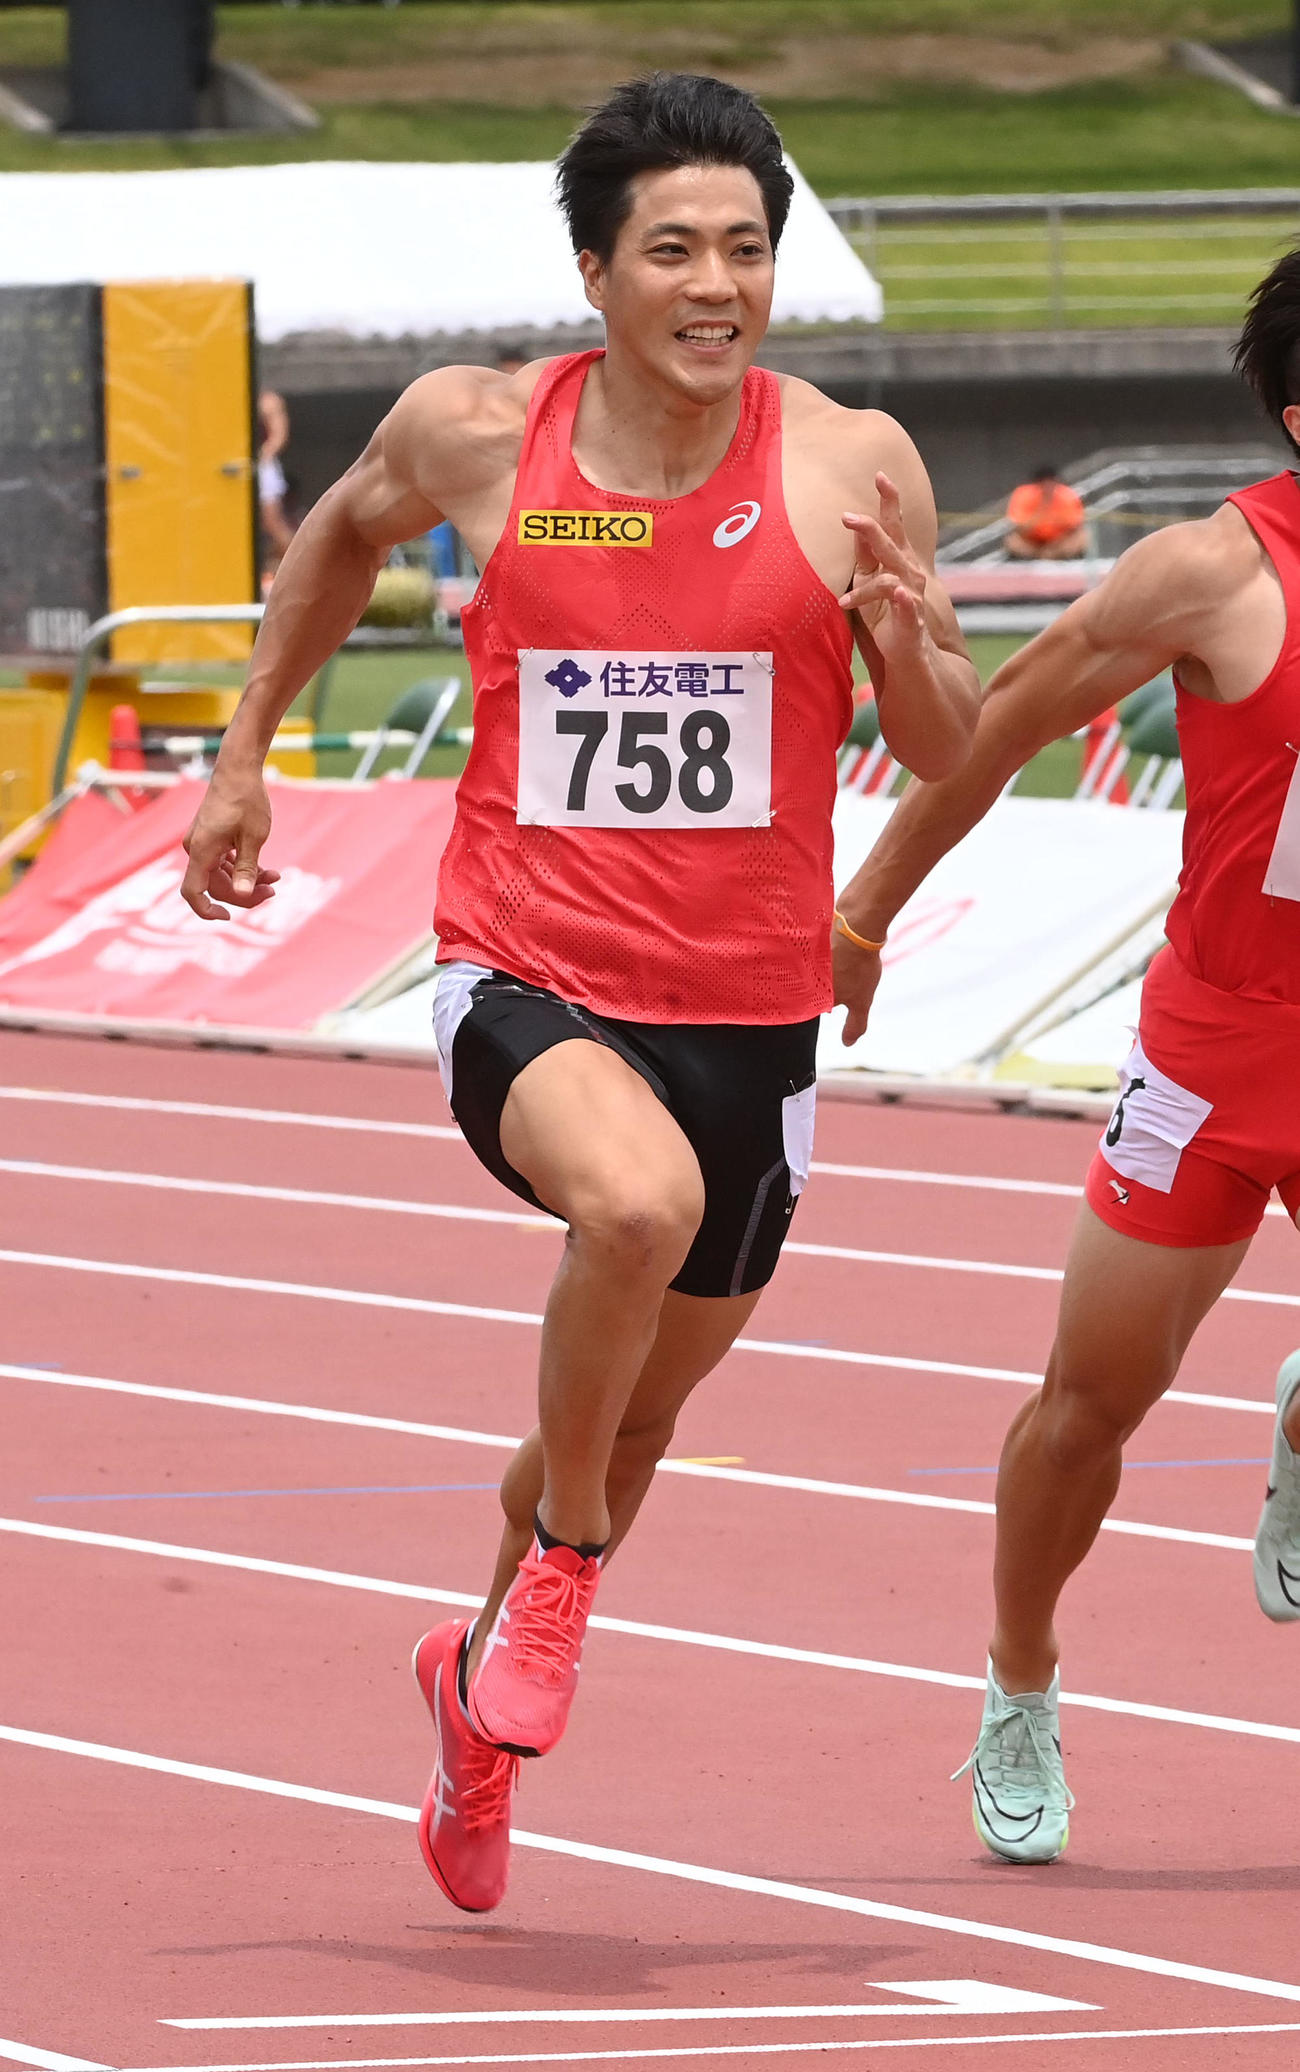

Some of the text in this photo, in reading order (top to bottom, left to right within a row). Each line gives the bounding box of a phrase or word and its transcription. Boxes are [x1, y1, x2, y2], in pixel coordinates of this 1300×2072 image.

[523, 515, 647, 541] SEIKO
[600, 660, 745, 698] 住友電工
[555, 709, 734, 814] 758
